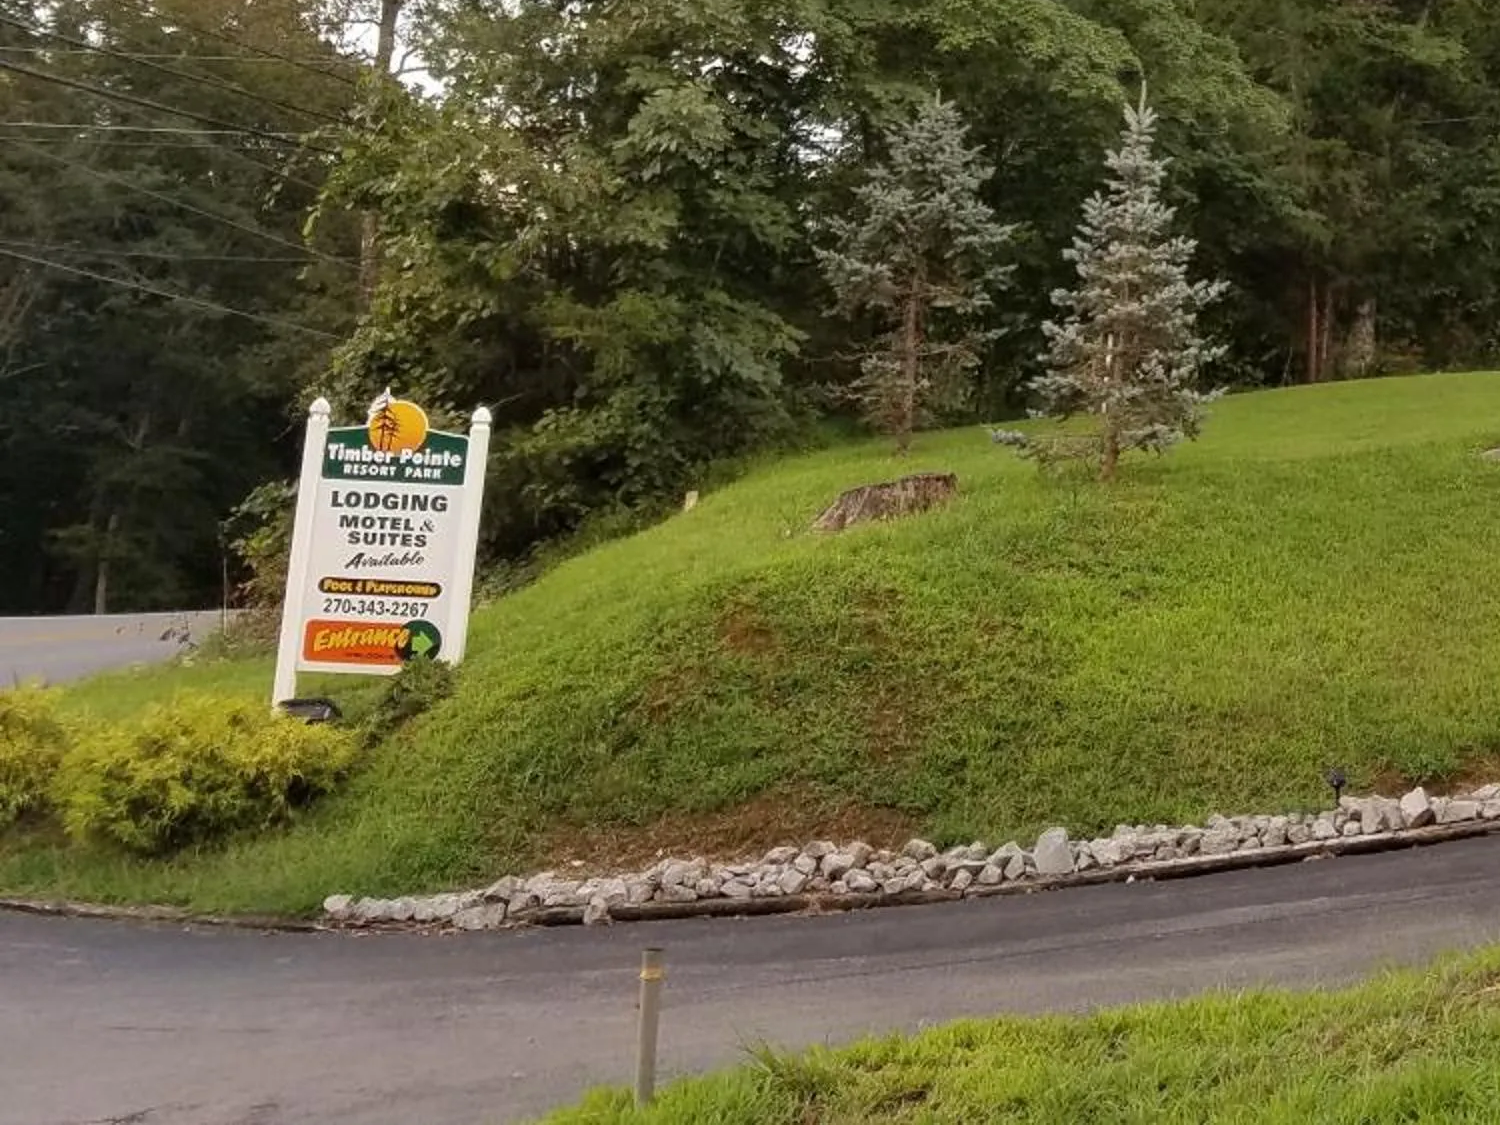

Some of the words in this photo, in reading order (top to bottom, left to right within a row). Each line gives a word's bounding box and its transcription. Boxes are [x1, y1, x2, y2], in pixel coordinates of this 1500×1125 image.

[327, 443, 395, 464] Timber
[400, 448, 463, 467] Pointe
[343, 463, 397, 476] RESORT
[405, 466, 443, 479] PARK
[331, 490, 448, 512] LODGING
[339, 515, 415, 531] MOTEL
[419, 518, 436, 533] &
[347, 531, 428, 548] SUITES
[344, 551, 425, 569] Available
[323, 598, 429, 618] 270-343-2267
